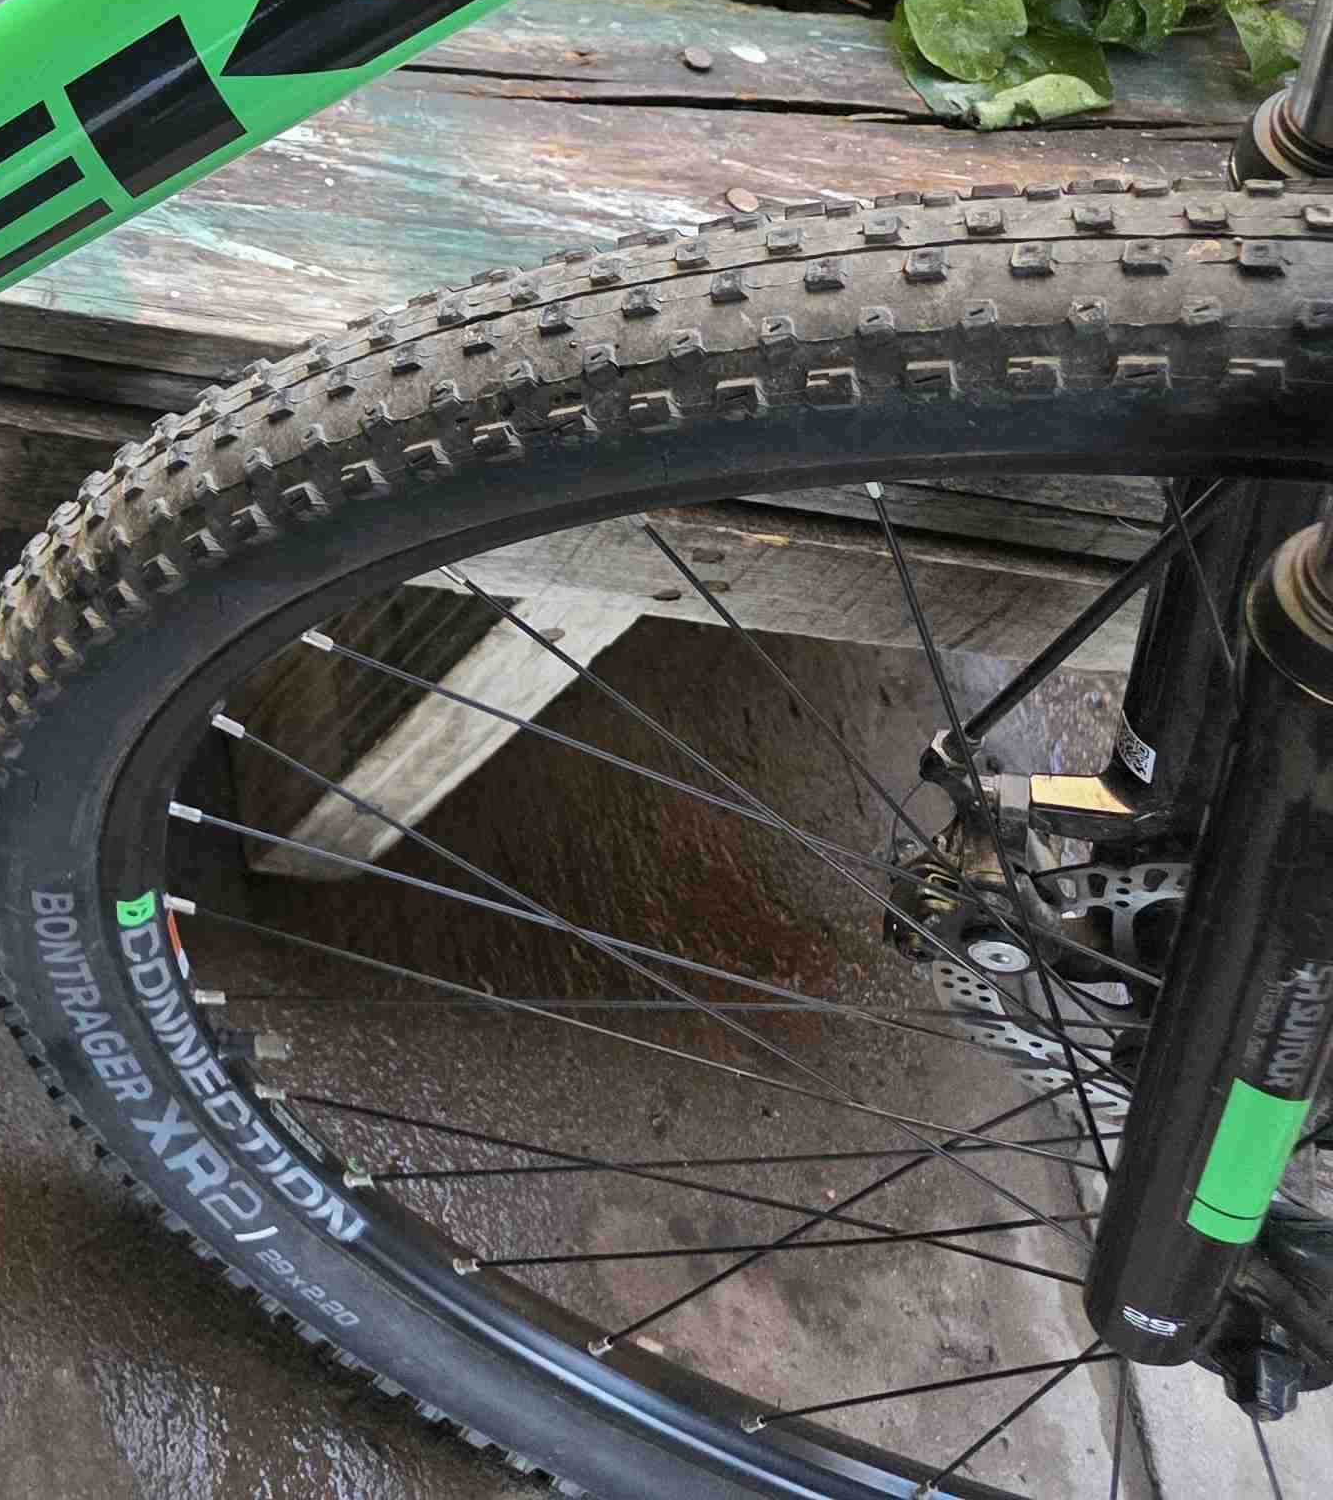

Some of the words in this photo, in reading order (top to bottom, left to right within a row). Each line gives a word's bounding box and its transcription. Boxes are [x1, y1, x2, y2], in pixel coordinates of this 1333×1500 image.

[32, 890, 154, 1103] BONTRAGER
[119, 922, 369, 1242] CONNECTION
[131, 1098, 263, 1231] XR2
